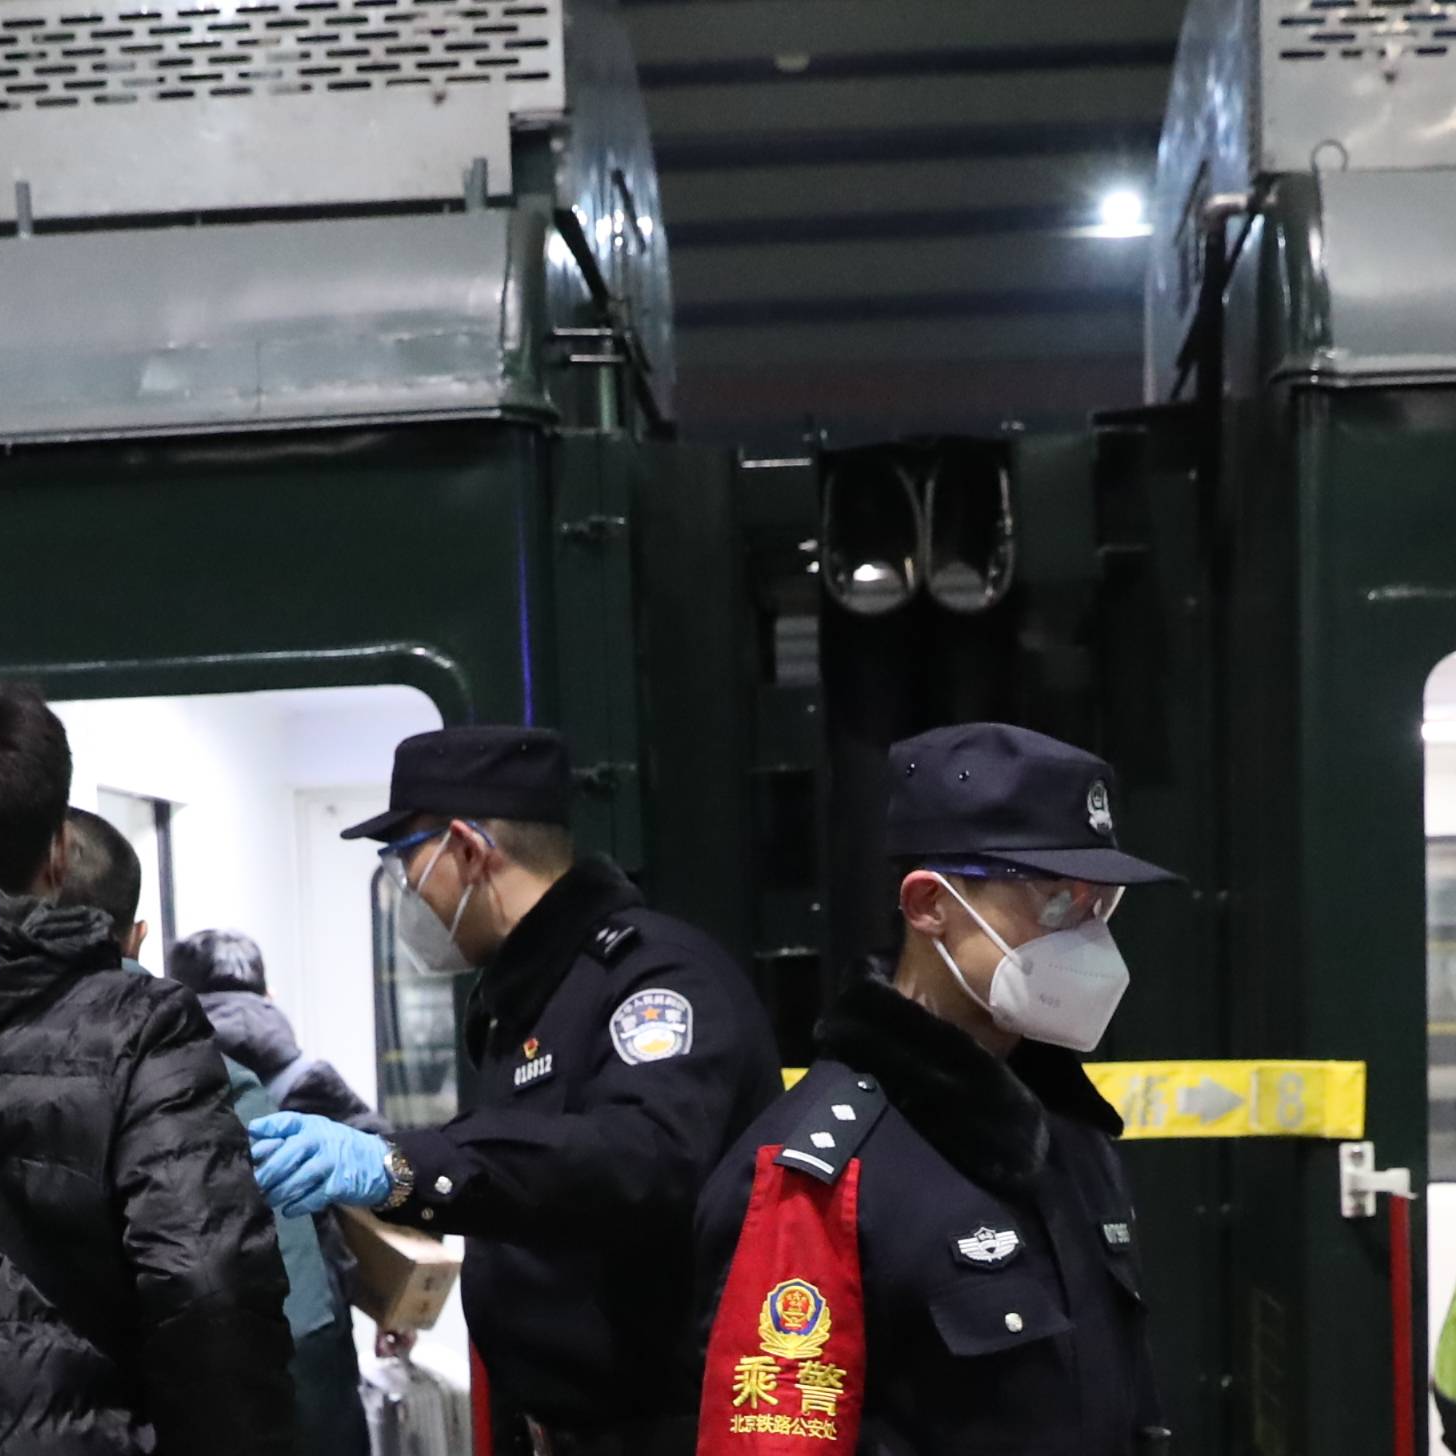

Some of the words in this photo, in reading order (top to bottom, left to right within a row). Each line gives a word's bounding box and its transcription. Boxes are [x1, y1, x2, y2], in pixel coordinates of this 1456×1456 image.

[732, 1355, 847, 1417] 乘警
[730, 1413, 838, 1441] 北京铁路公安处
